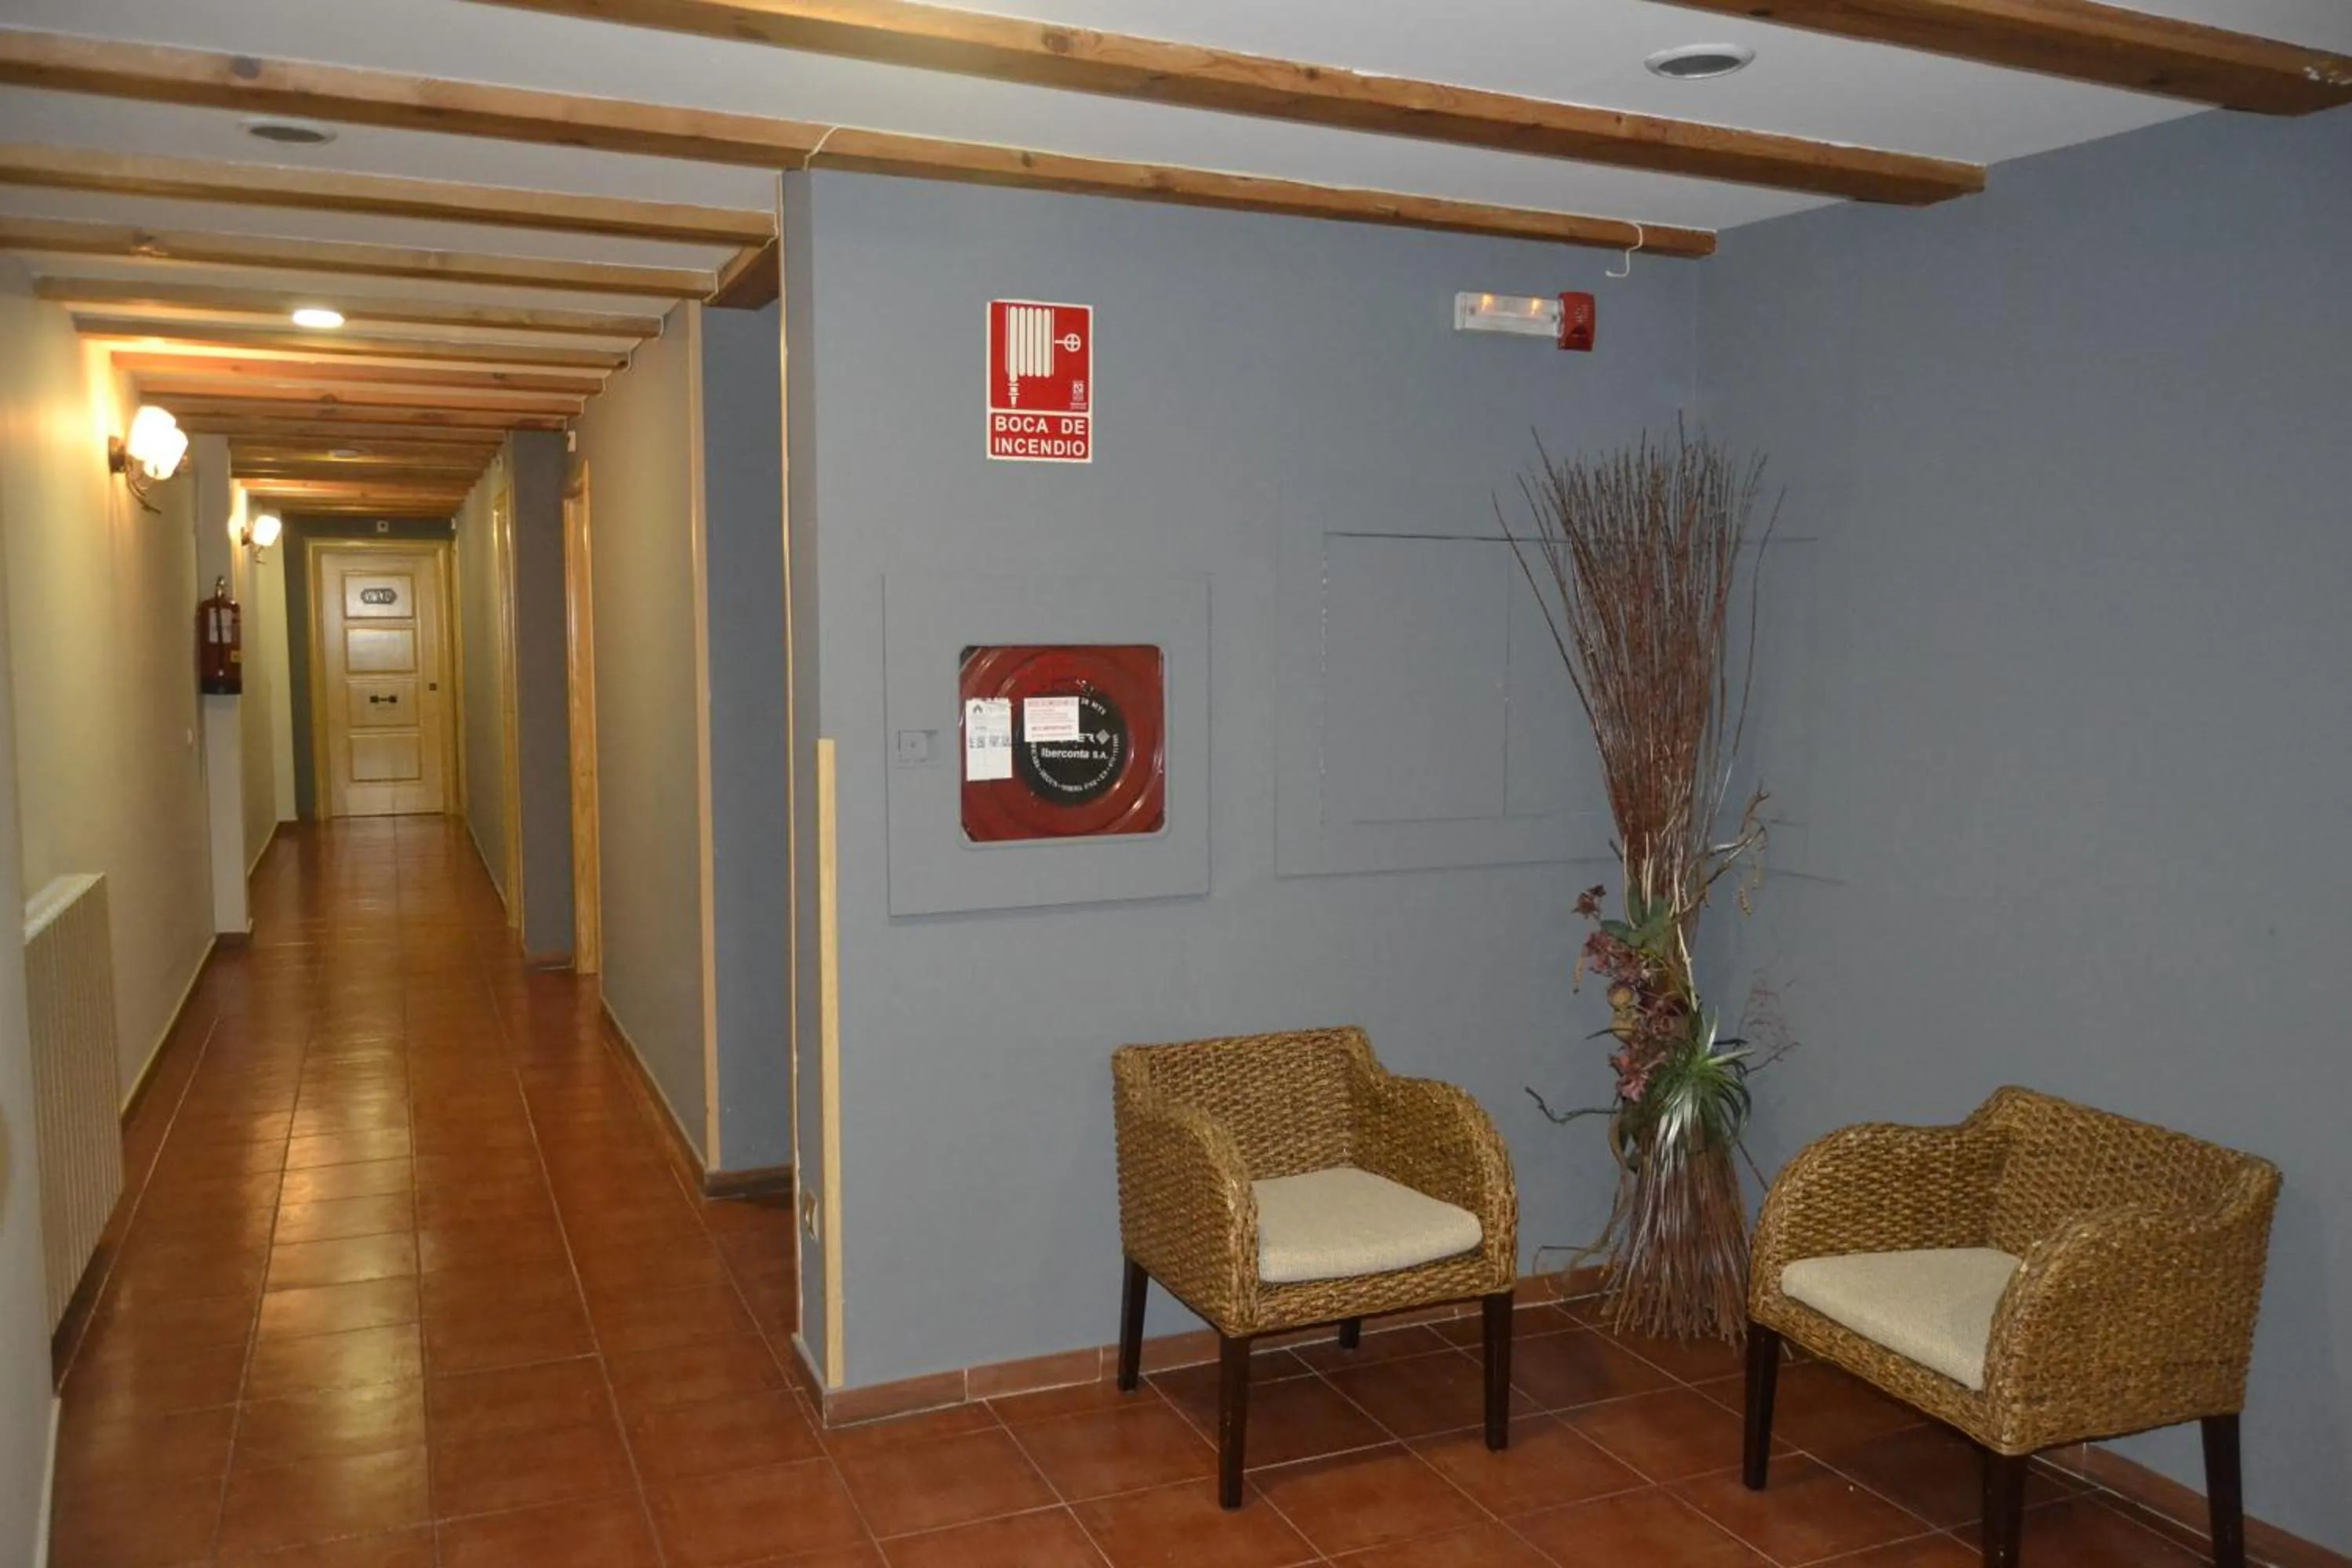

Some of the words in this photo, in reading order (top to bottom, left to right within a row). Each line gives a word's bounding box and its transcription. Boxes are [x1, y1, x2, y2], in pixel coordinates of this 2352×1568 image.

[995, 415, 1049, 434] BOCA
[1061, 418, 1086, 435] DE
[995, 437, 1086, 456] INCENDIO
[1040, 747, 1090, 759] Iberconta
